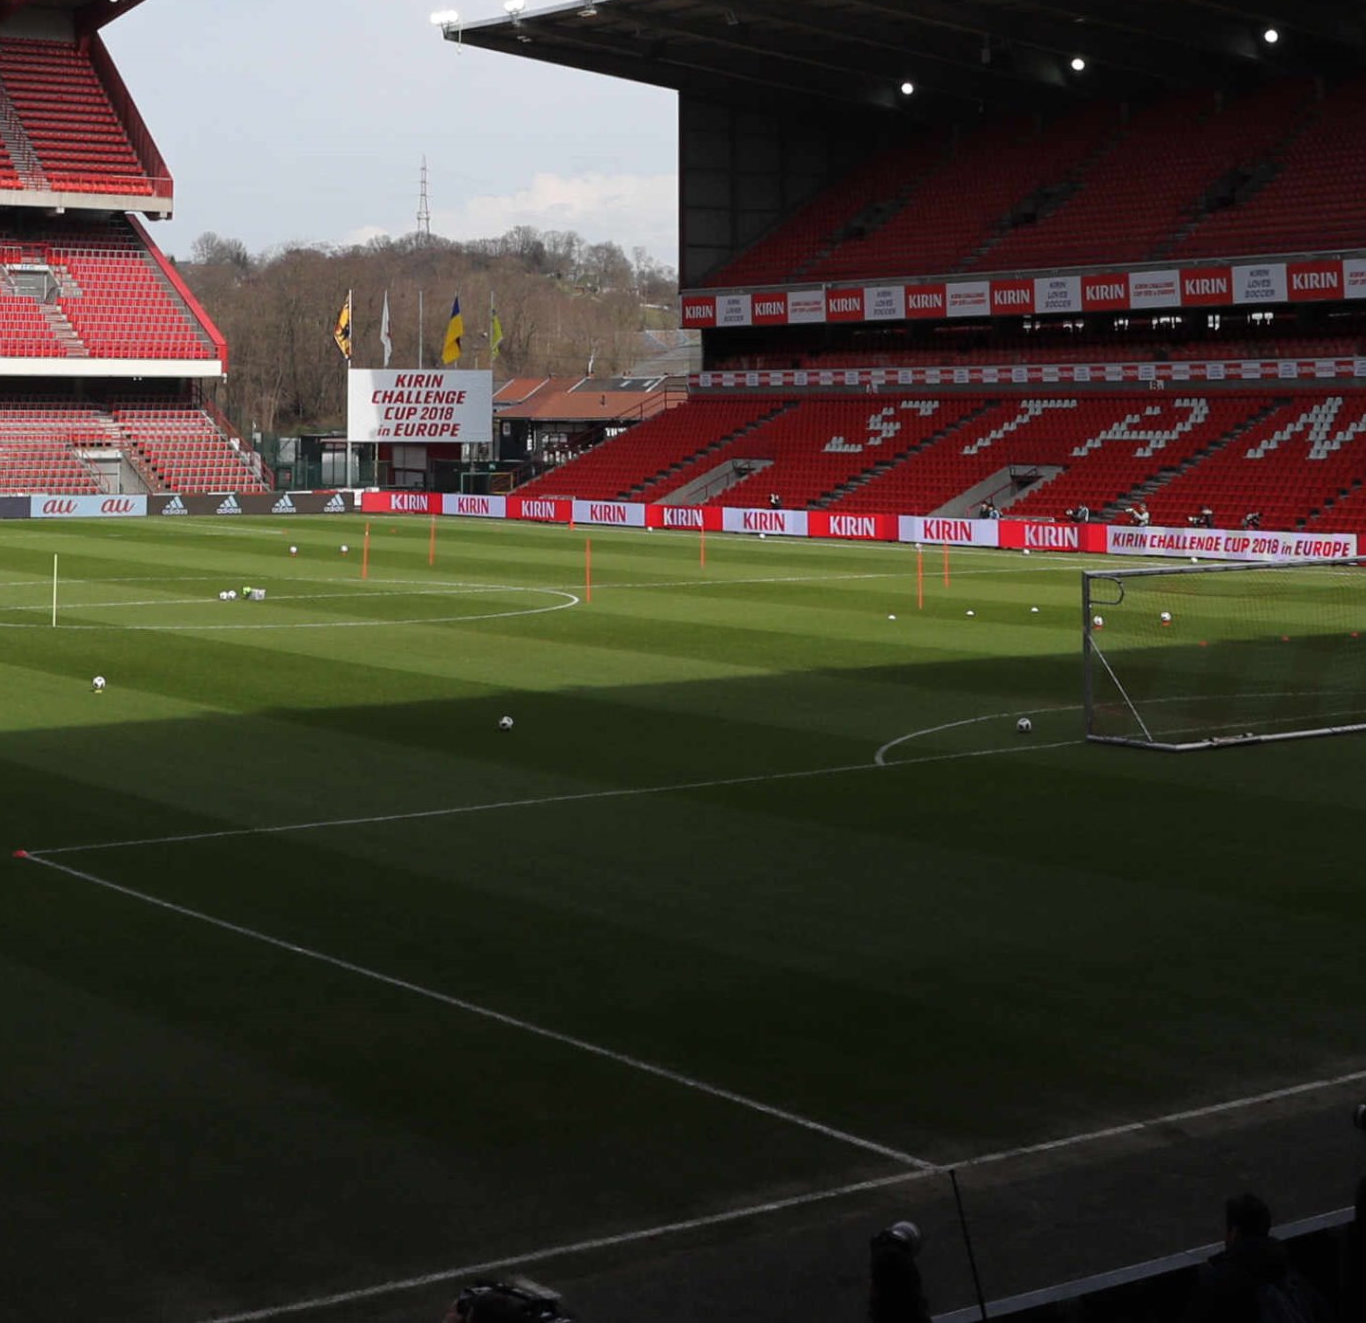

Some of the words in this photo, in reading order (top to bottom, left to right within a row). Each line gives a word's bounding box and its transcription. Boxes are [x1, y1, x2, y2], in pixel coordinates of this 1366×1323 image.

[1185, 278, 1227, 295] KIRIN
[1292, 271, 1338, 290] KIRIN
[994, 288, 1031, 305] KIRIN
[1086, 283, 1125, 301] KIRIN
[754, 301, 785, 316] KIRIN
[829, 297, 861, 313] KIRIN
[908, 293, 942, 309] KIRIN
[685, 305, 713, 320] KIRIN
[395, 374, 444, 388] KIRIN
[371, 390, 467, 405] CHALLENGE
[384, 407, 417, 421] CUP
[420, 407, 454, 420] 2018
[377, 424, 390, 436] in
[393, 423, 461, 437] EUROPE
[42, 497, 78, 514] au
[100, 496, 136, 514] au
[216, 506, 242, 514] adidas
[271, 505, 296, 513] adidas
[324, 504, 345, 513] adidas
[391, 493, 428, 511] KIRIN
[458, 497, 489, 514] KIRIN
[521, 500, 555, 519] KIRIN
[162, 507, 188, 515] adidas
[590, 504, 627, 523] KIRIN
[663, 507, 703, 527] KIRIN
[743, 511, 785, 532] KIRIN
[829, 515, 875, 537] KIRIN
[923, 520, 972, 542] KIRIN
[1025, 524, 1079, 549] KIRIN
[1112, 532, 1147, 549] KIRIN
[1149, 534, 1221, 553] CHALLENGE
[1223, 537, 1250, 554] CUP
[1252, 538, 1279, 554] 2018
[1281, 542, 1292, 554] in
[1294, 540, 1351, 558] EUROPE
